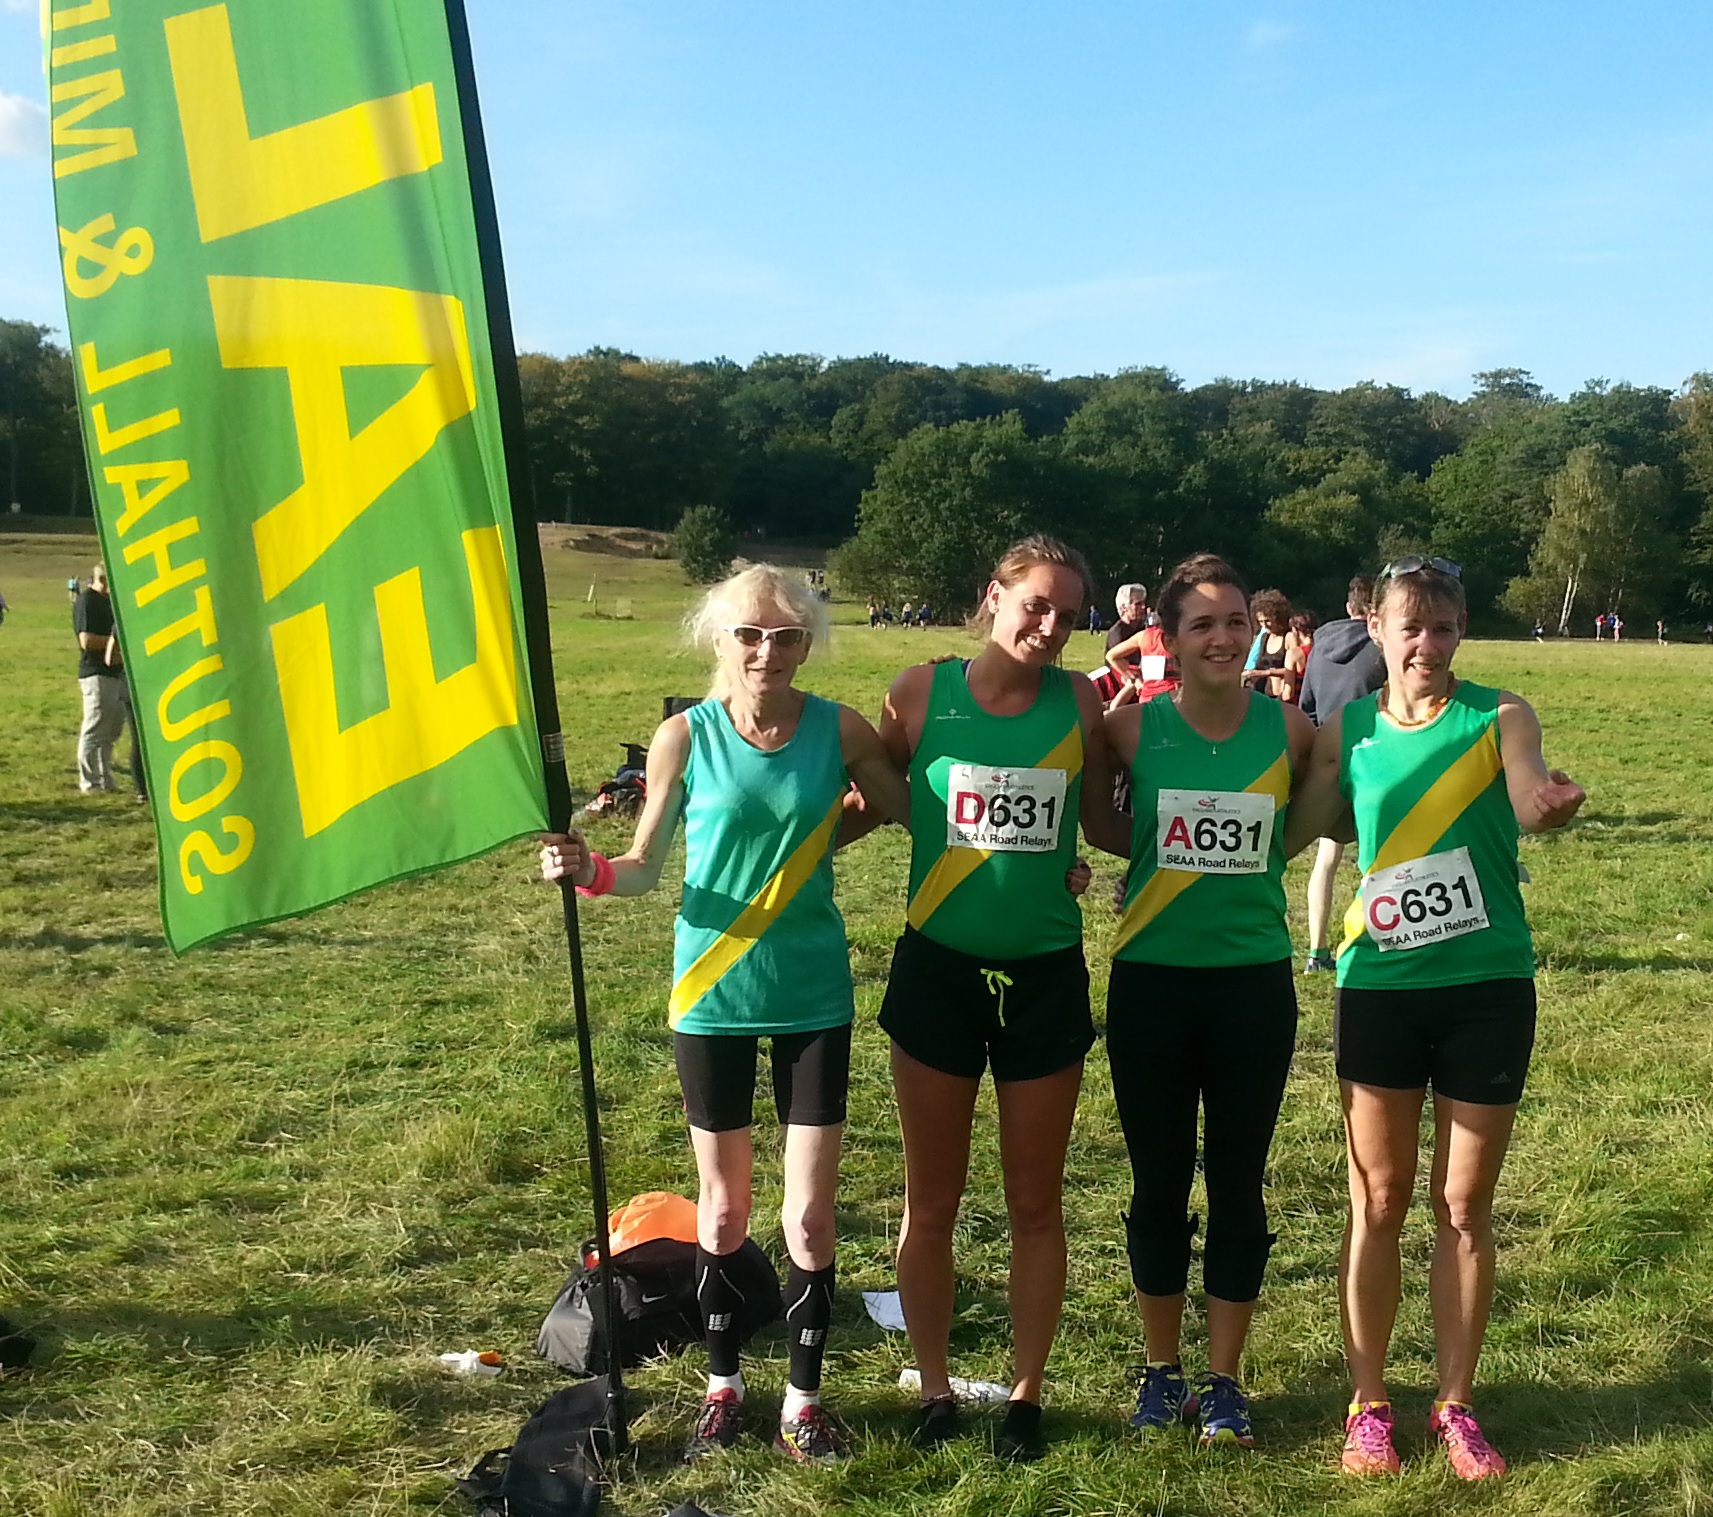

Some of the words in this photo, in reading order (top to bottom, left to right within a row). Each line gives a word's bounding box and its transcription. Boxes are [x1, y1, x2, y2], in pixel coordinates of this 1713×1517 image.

[955, 791, 1056, 830] D631
[956, 830, 987, 843] SEAA
[989, 833, 1018, 845] Road
[1162, 816, 1263, 853] A631
[1166, 854, 1196, 867] SEAA
[1198, 857, 1226, 868] Road
[1228, 858, 1260, 871] Relays
[1369, 875, 1474, 932] C631
[1413, 924, 1442, 941] Road
[1443, 916, 1480, 934] Relays
